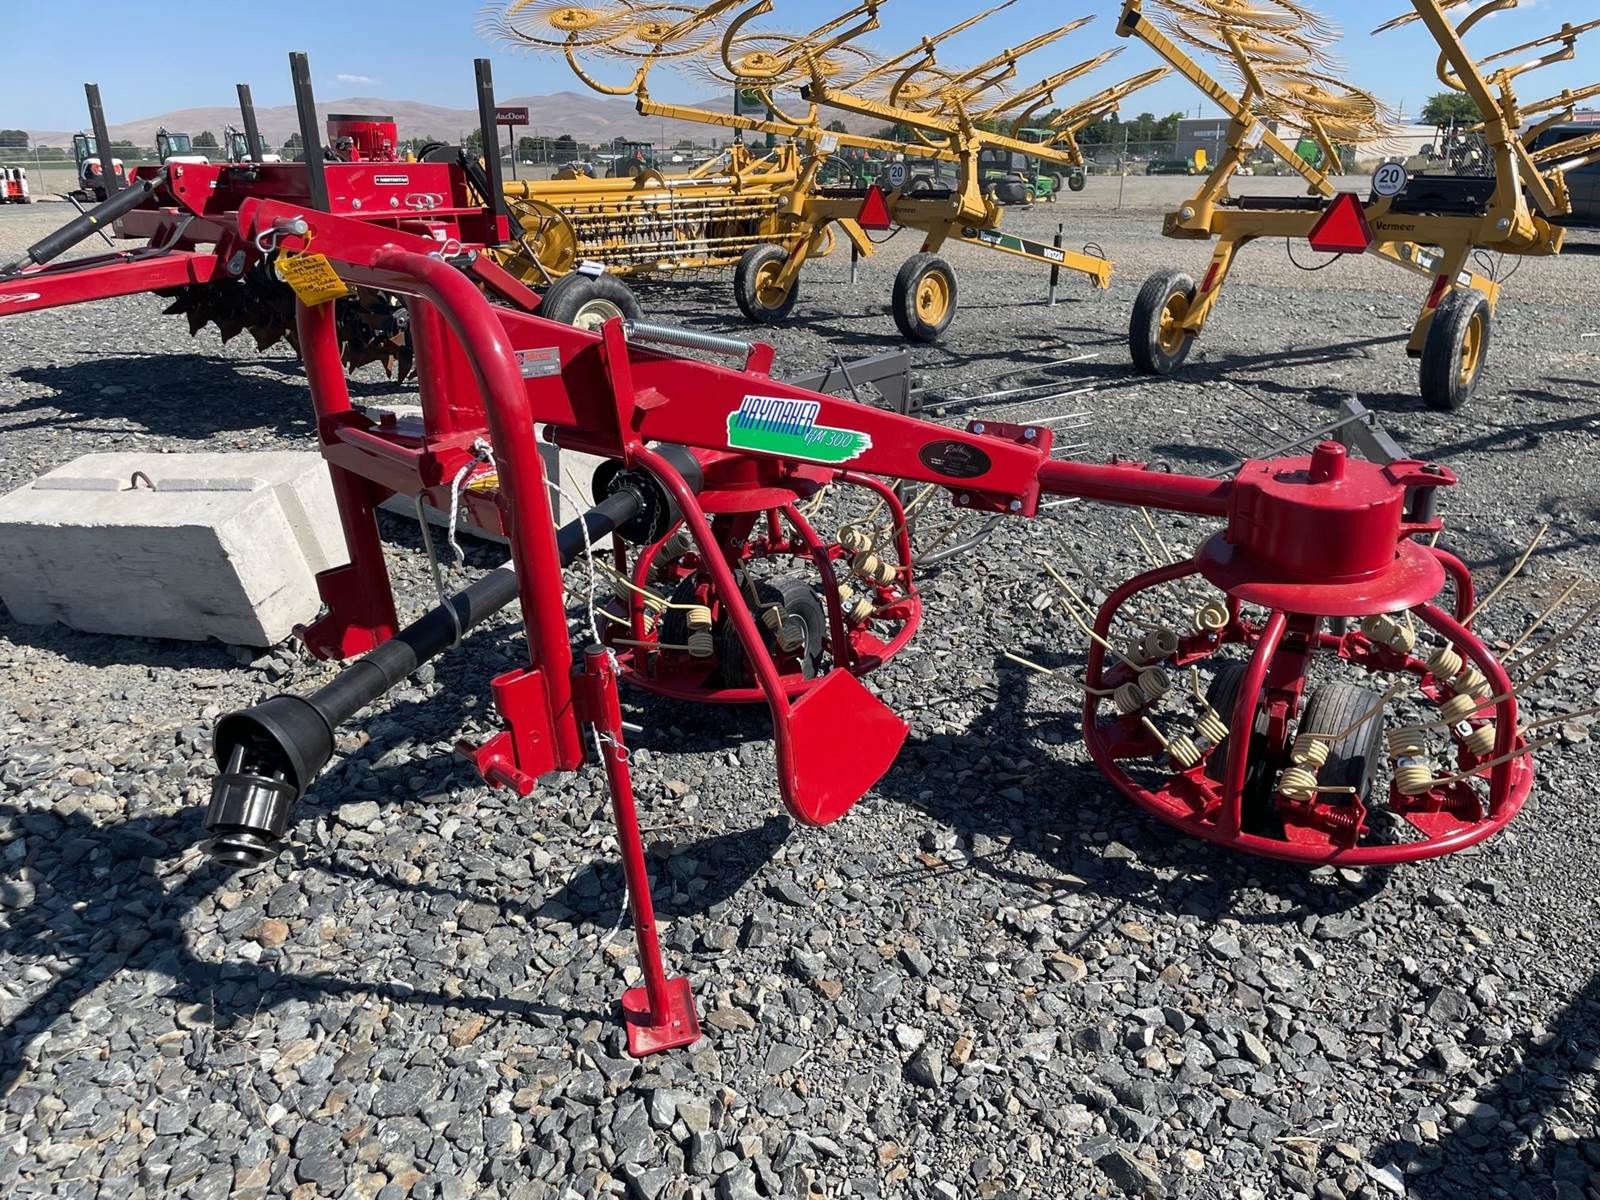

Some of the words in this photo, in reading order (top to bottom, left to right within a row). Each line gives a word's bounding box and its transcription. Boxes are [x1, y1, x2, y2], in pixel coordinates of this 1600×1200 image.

[891, 166, 903, 178] 20
[1379, 169, 1399, 183] 20
[1376, 220, 1416, 231] Vermeer
[736, 398, 819, 437] HAYMAKER
[805, 428, 825, 446] HM
[827, 431, 854, 447] 300
